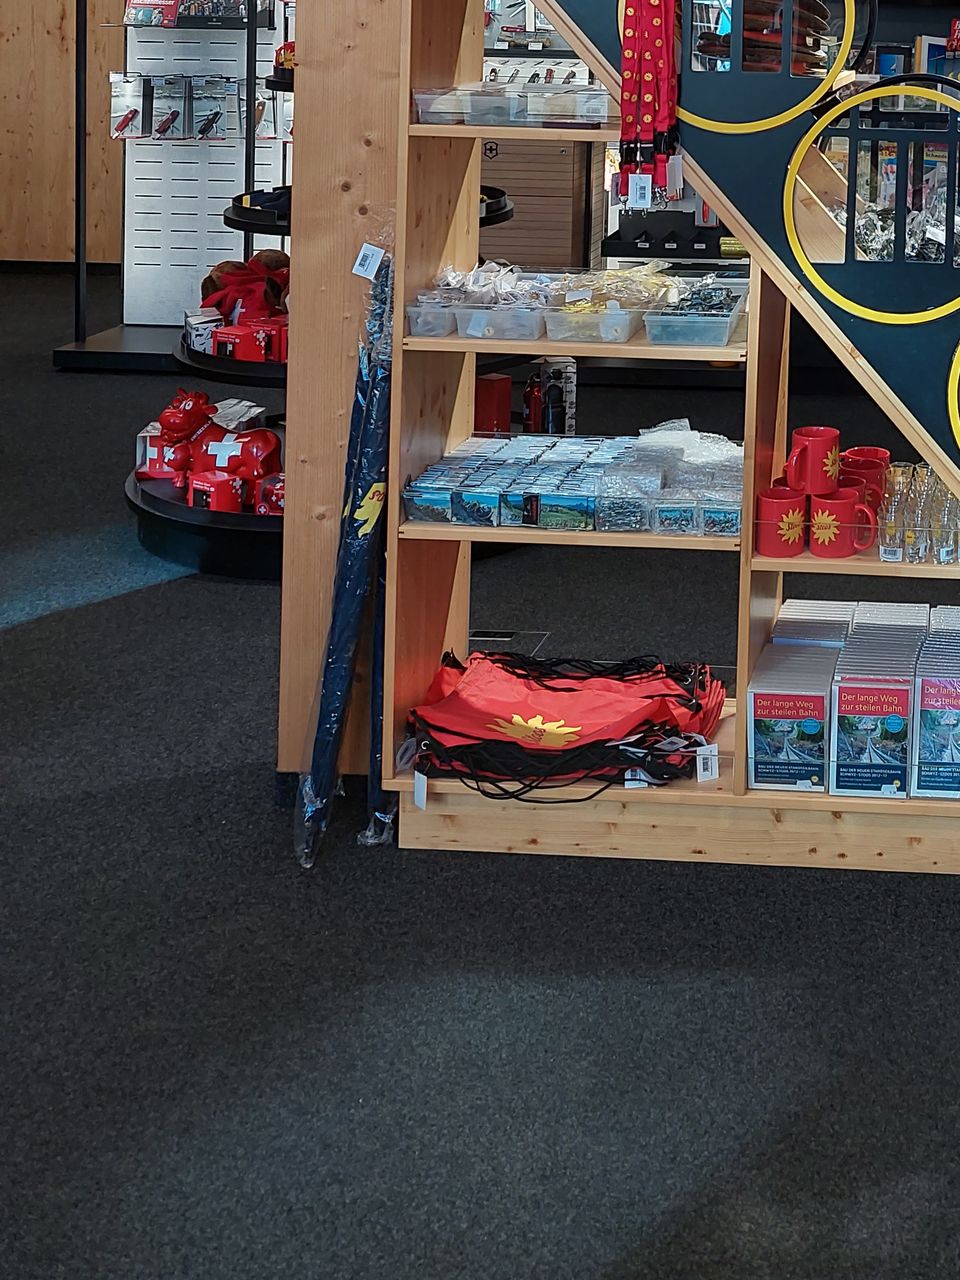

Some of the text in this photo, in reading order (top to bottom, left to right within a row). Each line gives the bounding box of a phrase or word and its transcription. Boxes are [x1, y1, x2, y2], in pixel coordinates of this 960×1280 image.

[924, 686, 939, 694] Der
[841, 693, 898, 703] Der lange Weg
[757, 699, 814, 709] Der lange Weg
[855, 703, 881, 712] steilen
[883, 704, 903, 713] Bahn
[771, 707, 797, 716] steilen
[799, 709, 819, 718] Bahn
